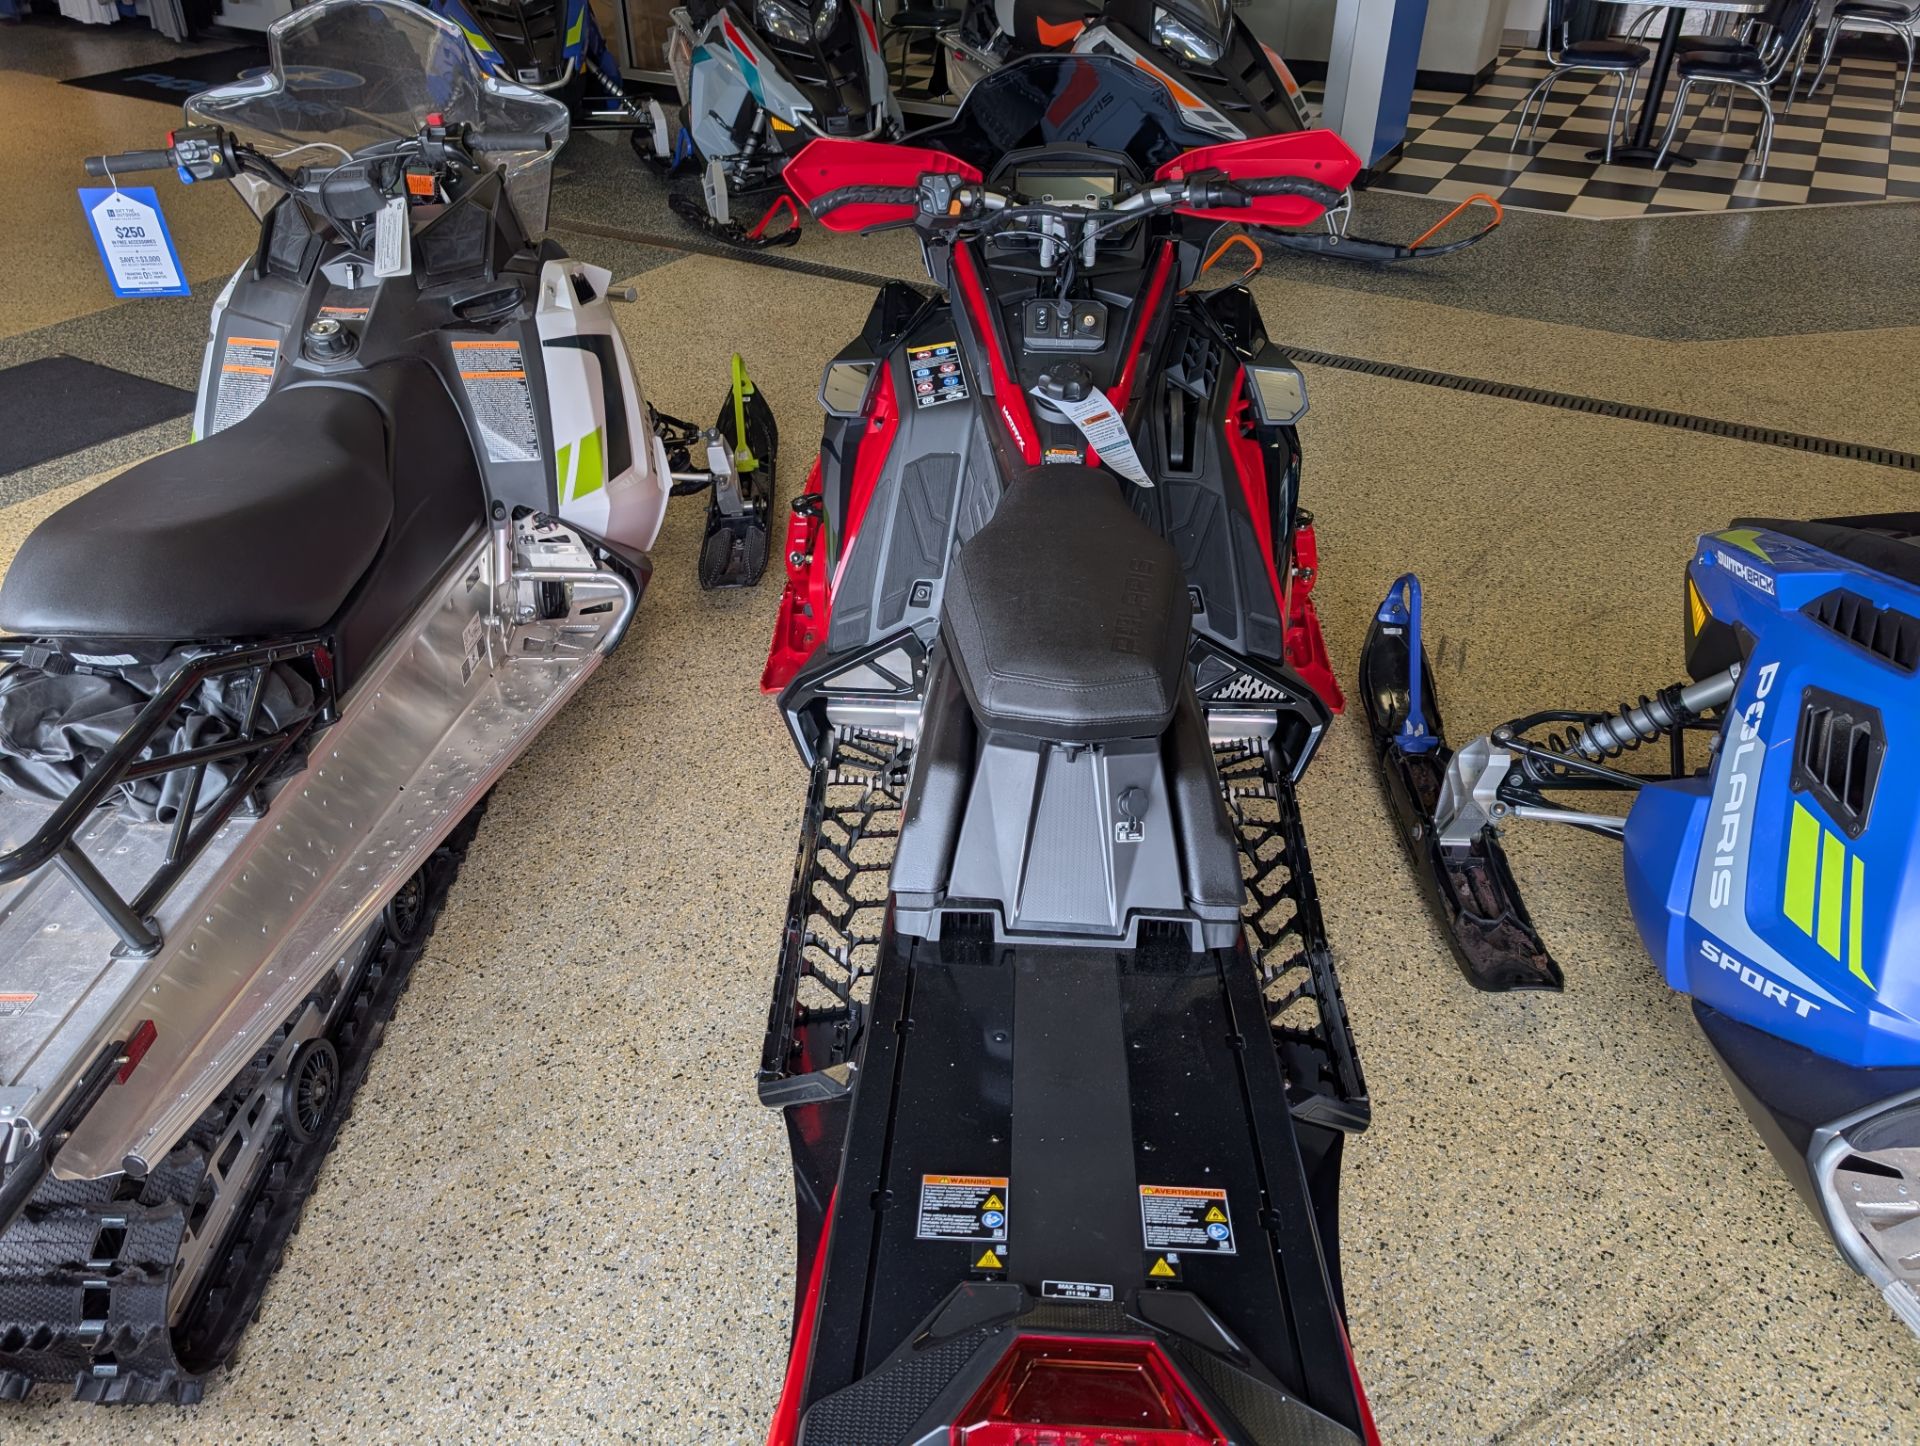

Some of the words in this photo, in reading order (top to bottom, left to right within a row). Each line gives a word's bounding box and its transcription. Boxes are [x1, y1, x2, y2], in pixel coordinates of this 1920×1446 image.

[1066, 92, 1114, 141] OLARIS
[115, 226, 145, 239] $250
[1717, 550, 1775, 595] SWITCHBACK
[1709, 661, 1781, 909] POLARIS
[1700, 939, 1821, 1018] SPORT
[1153, 1188, 1224, 1197] AVERTISSEMENT
